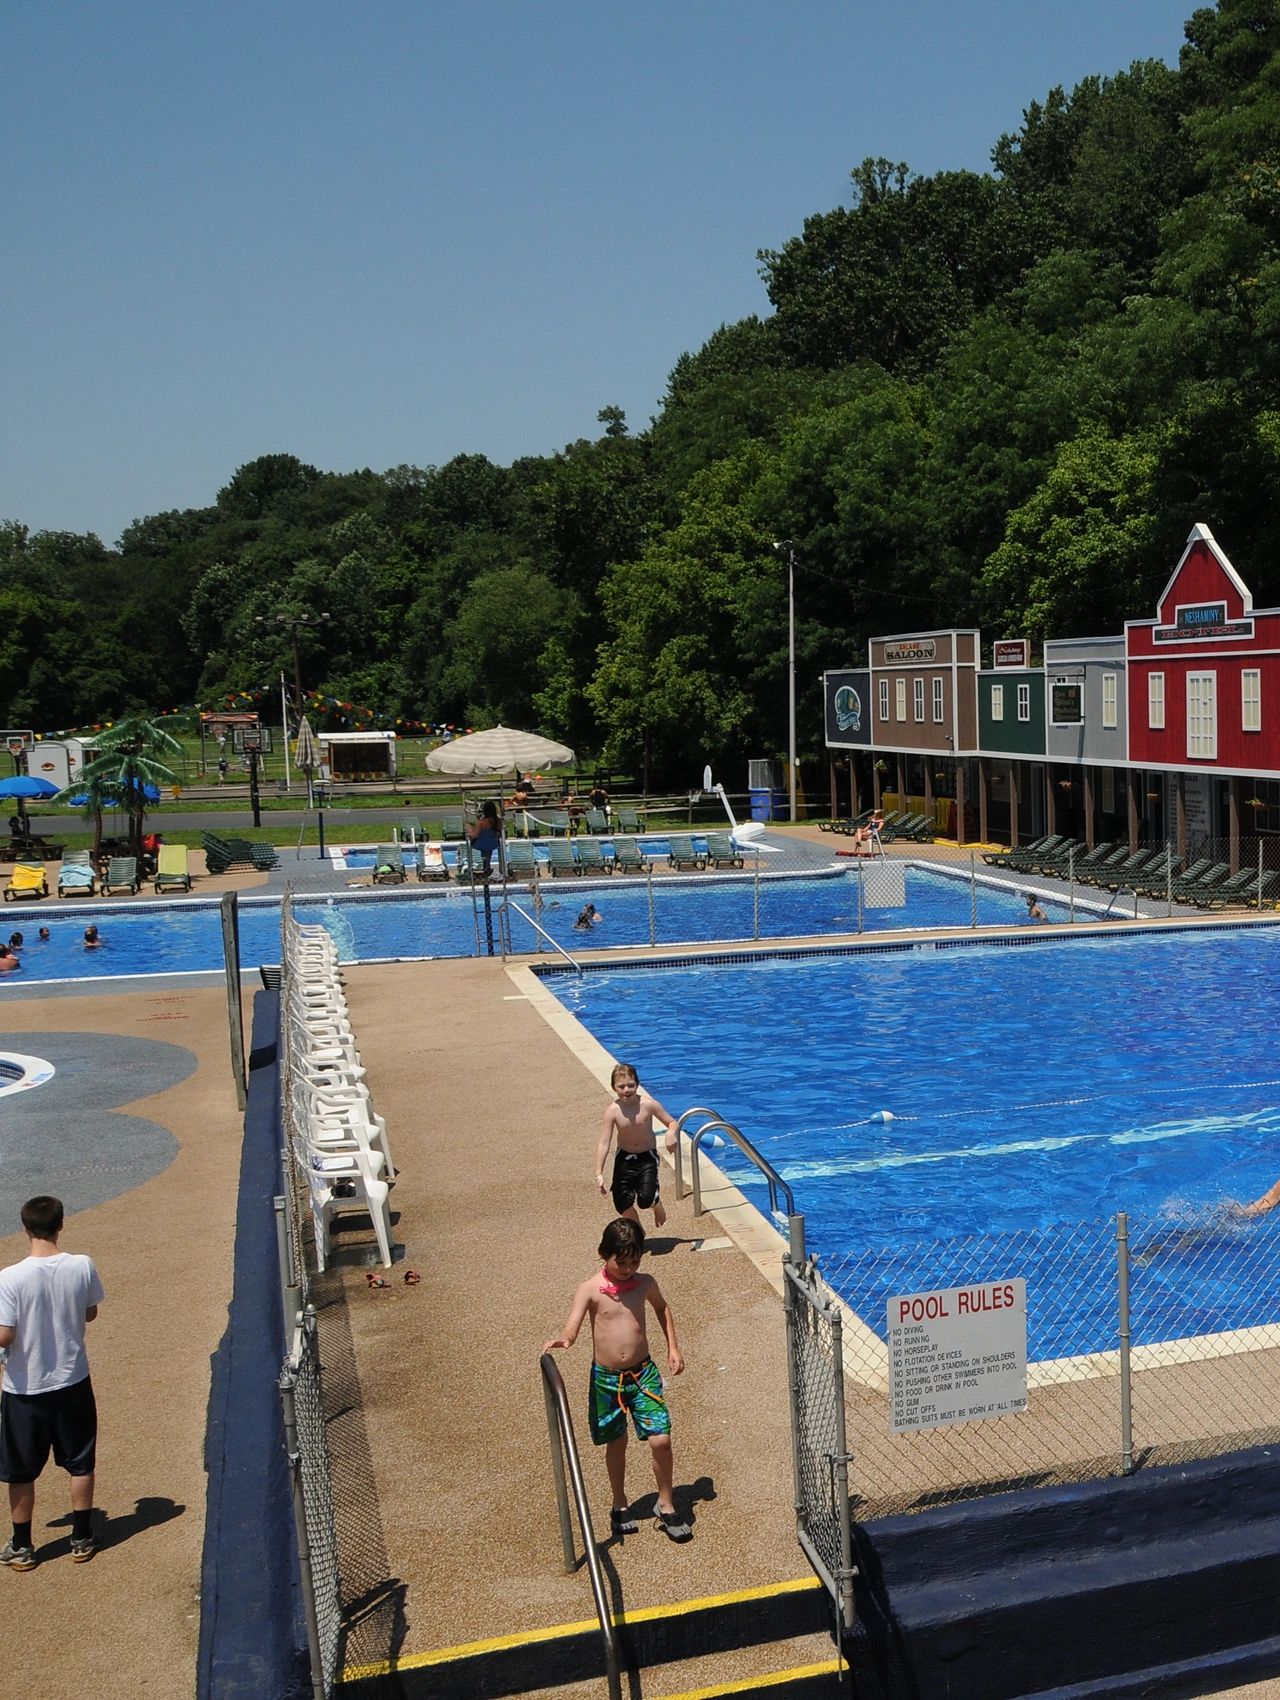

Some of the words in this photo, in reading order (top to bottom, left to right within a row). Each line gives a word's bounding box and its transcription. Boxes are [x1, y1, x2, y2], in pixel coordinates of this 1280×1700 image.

[1184, 609, 1219, 624] NESHAMINY
[887, 649, 933, 660] SALOON
[900, 1295, 949, 1323] POOL
[958, 1285, 1014, 1315] RULES
[893, 1328, 902, 1336] NO
[904, 1325, 924, 1335] DIVING
[893, 1339, 902, 1347] NO
[904, 1335, 930, 1346] RUNNING
[904, 1344, 939, 1356] HORSEPLAY
[894, 1360, 902, 1368] NO
[905, 1355, 935, 1366] FLOTATION
[938, 1350, 962, 1361] DEVICES
[894, 1370, 903, 1378] NO
[906, 1366, 928, 1376] SITTING
[931, 1364, 939, 1372] OR
[942, 1359, 969, 1371] STANDING
[972, 1358, 980, 1366] ON
[983, 1352, 1016, 1364] SHOULDERS
[895, 1380, 903, 1389] NO
[906, 1376, 930, 1387] PUSHING
[933, 1373, 952, 1383] OTHER
[955, 1367, 984, 1379] SWIMMERS
[987, 1365, 1000, 1374] INTO
[1002, 1362, 1017, 1371] POOL
[895, 1390, 903, 1398] NO
[906, 1388, 922, 1397] FOOD
[924, 1386, 933, 1394] OR
[936, 1383, 952, 1392] DRINK
[962, 1379, 978, 1388] POOL
[895, 1400, 904, 1408] NO
[906, 1398, 919, 1407] GUM
[895, 1410, 904, 1418] NO
[906, 1407, 918, 1416] CUT
[920, 1404, 936, 1414] OFFS
[895, 1416, 919, 1427] BATHING
[922, 1413, 938, 1423] SUITS
[941, 1410, 956, 1420] MUST
[959, 1409, 966, 1417] BE
[969, 1406, 986, 1415] WORN
[988, 1404, 994, 1412] AT
[998, 1402, 1008, 1410] ALL
[1010, 1398, 1026, 1407] TIMES
